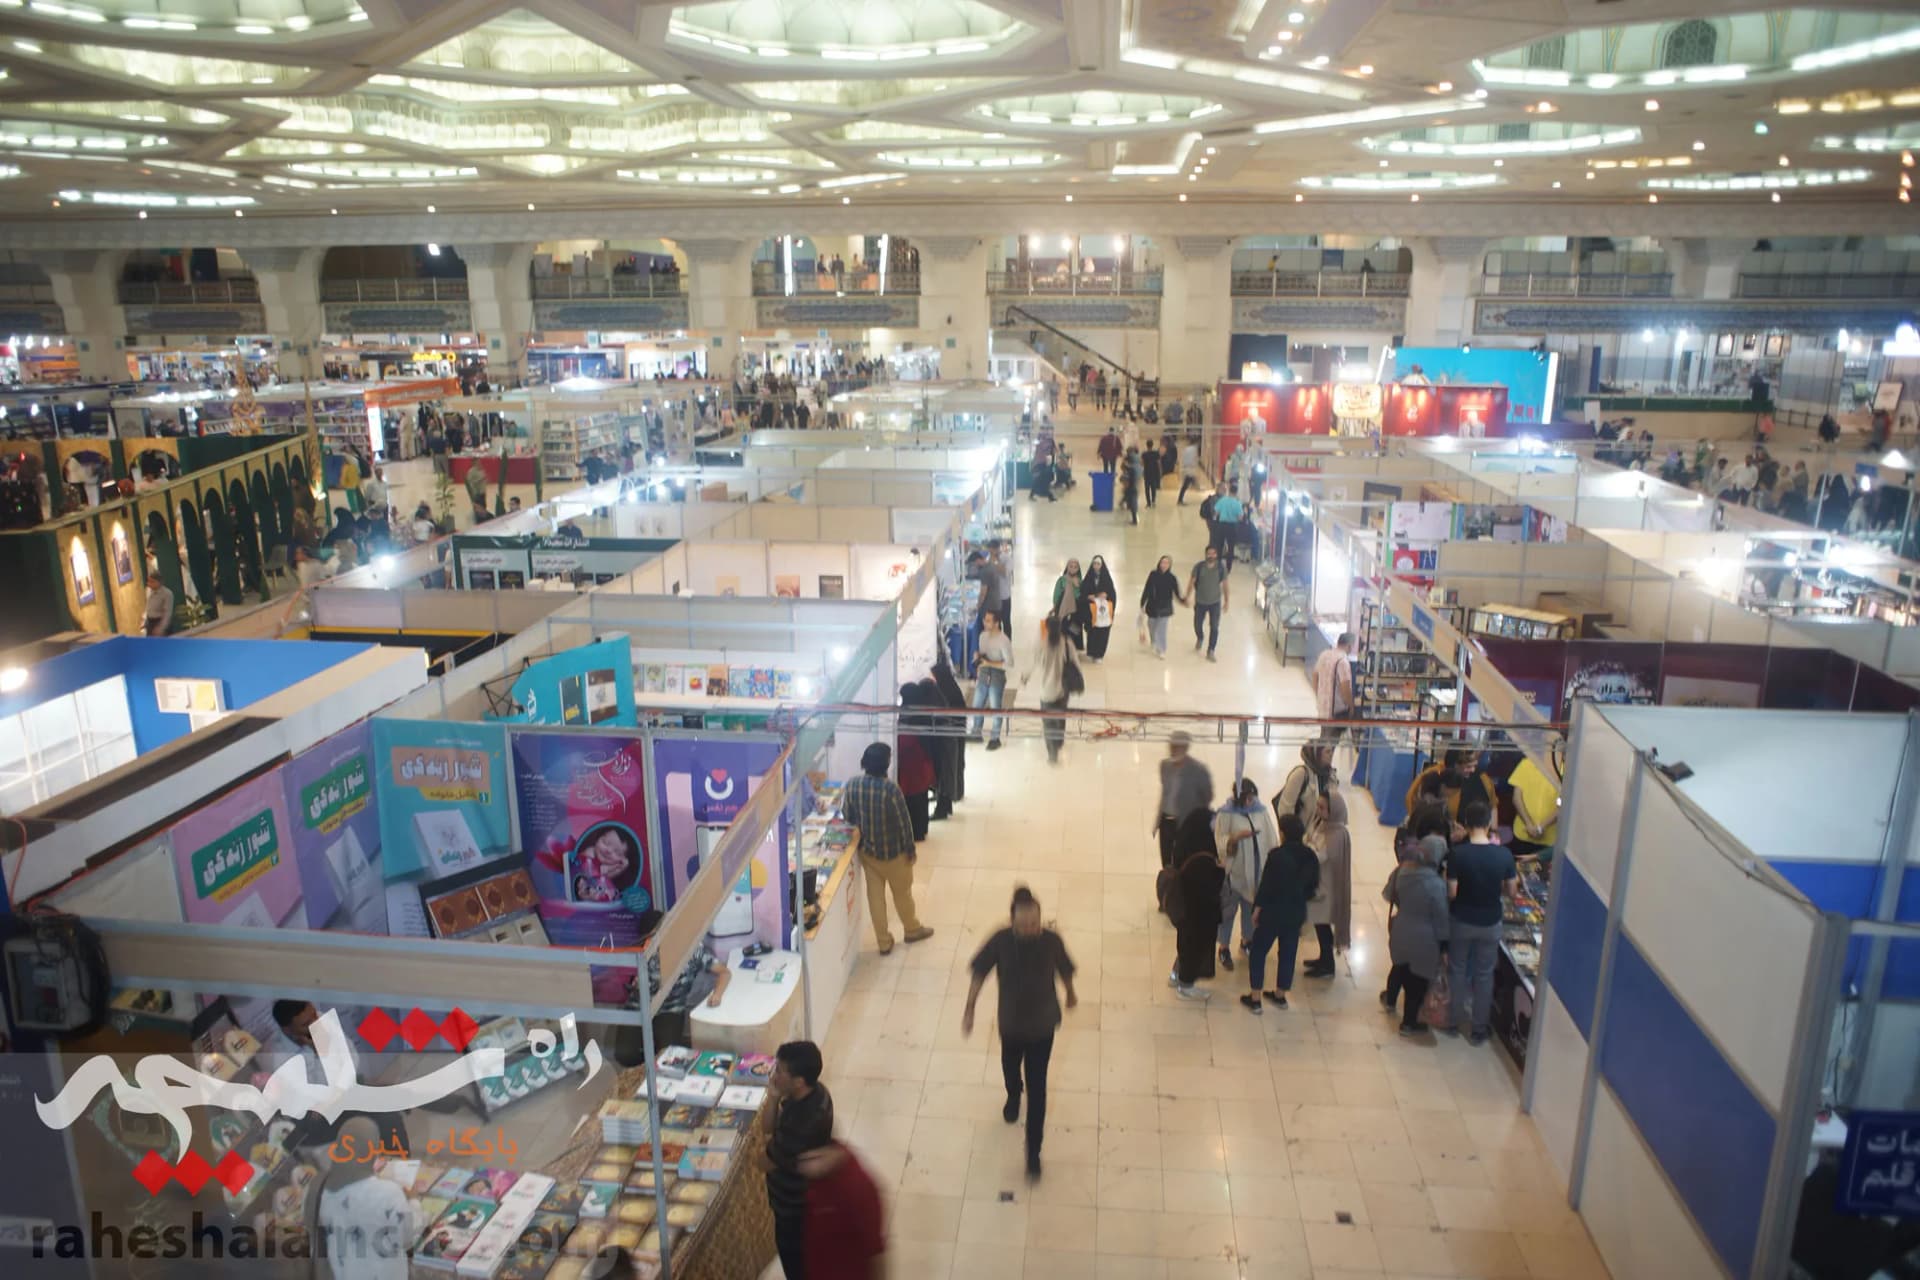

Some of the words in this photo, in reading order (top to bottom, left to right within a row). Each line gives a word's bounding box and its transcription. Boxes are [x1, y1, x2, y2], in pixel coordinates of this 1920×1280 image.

[343, 760, 365, 799] شور
[401, 755, 449, 784] زندگی
[453, 752, 482, 783] شور
[310, 779, 340, 820] ندگی
[248, 815, 272, 860] شور
[203, 836, 246, 888] زندگی
